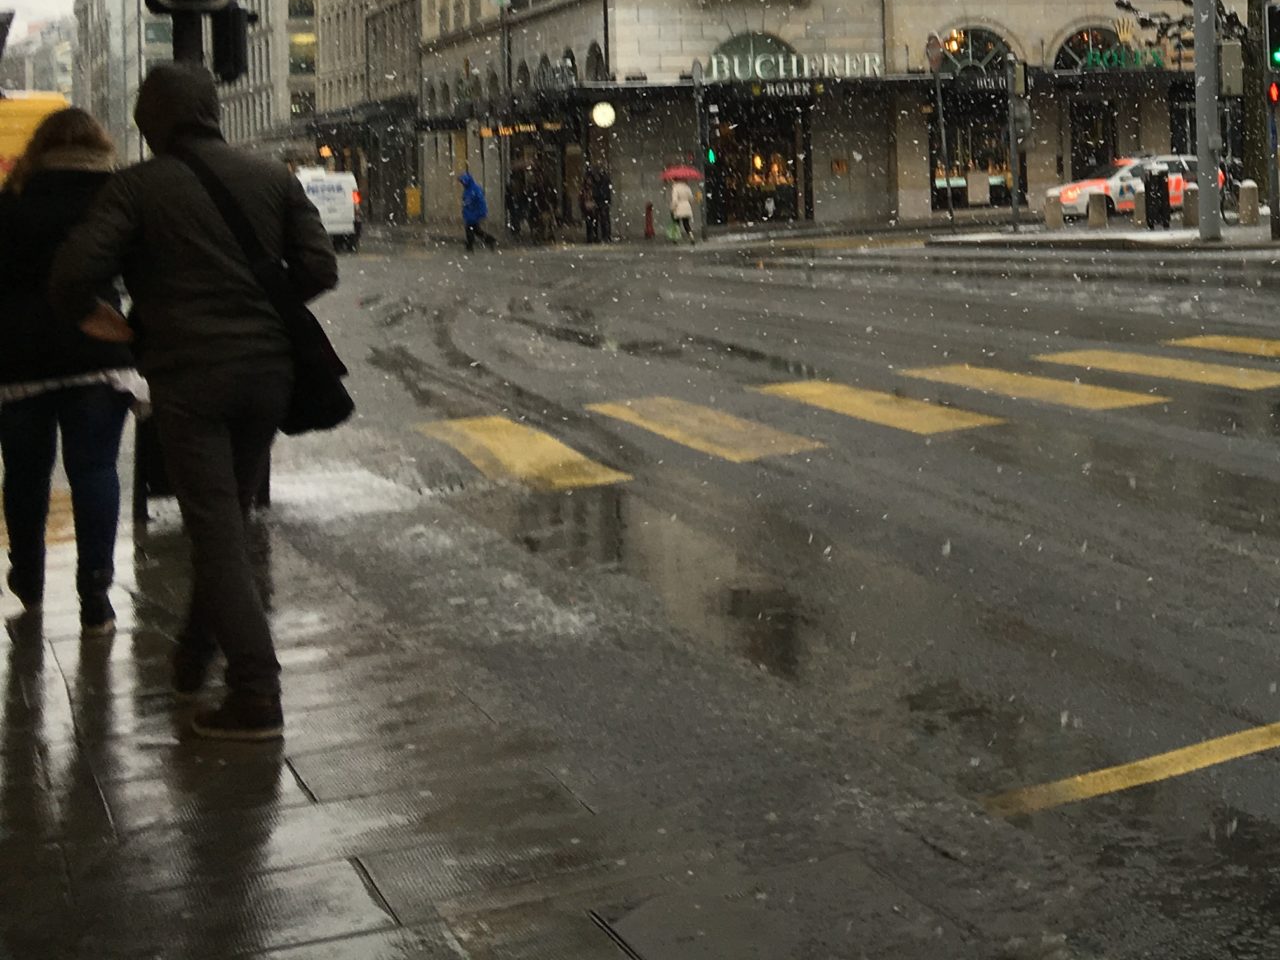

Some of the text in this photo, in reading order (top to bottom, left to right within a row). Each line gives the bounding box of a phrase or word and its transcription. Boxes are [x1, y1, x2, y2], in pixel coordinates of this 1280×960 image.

[711, 52, 882, 81] BUCHERER
[1087, 48, 1165, 68] ROLEX
[766, 82, 812, 97] ROLEX
